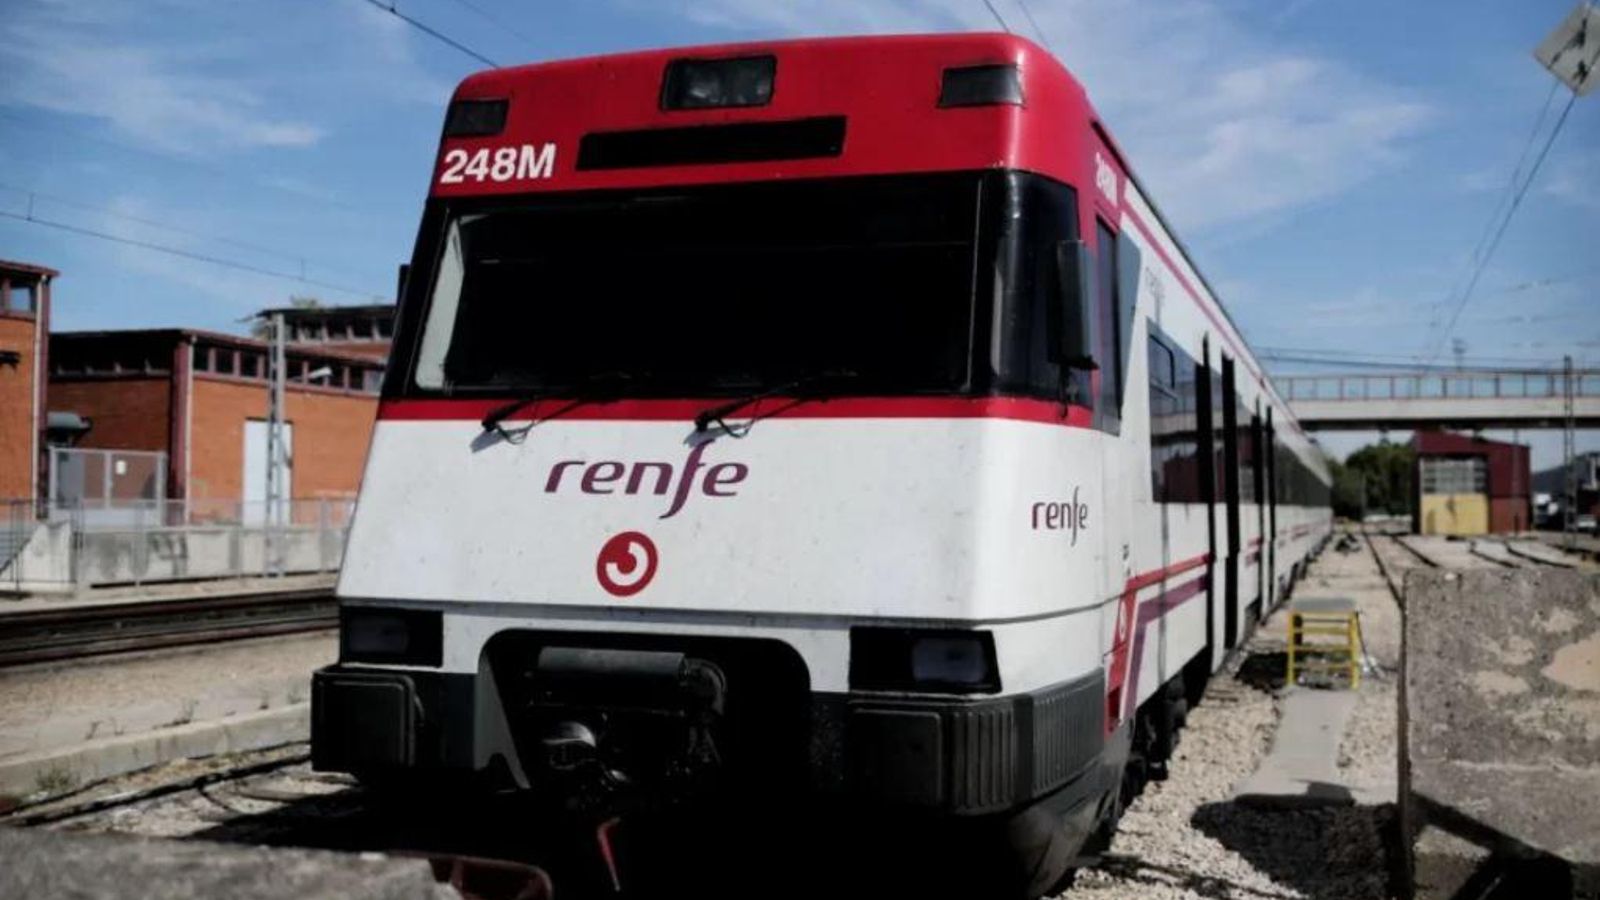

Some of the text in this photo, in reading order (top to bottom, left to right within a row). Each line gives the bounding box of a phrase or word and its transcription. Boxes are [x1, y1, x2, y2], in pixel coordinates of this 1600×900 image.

[440, 143, 556, 184] 248M
[544, 439, 749, 520] renfe
[1031, 486, 1088, 547] renfe
